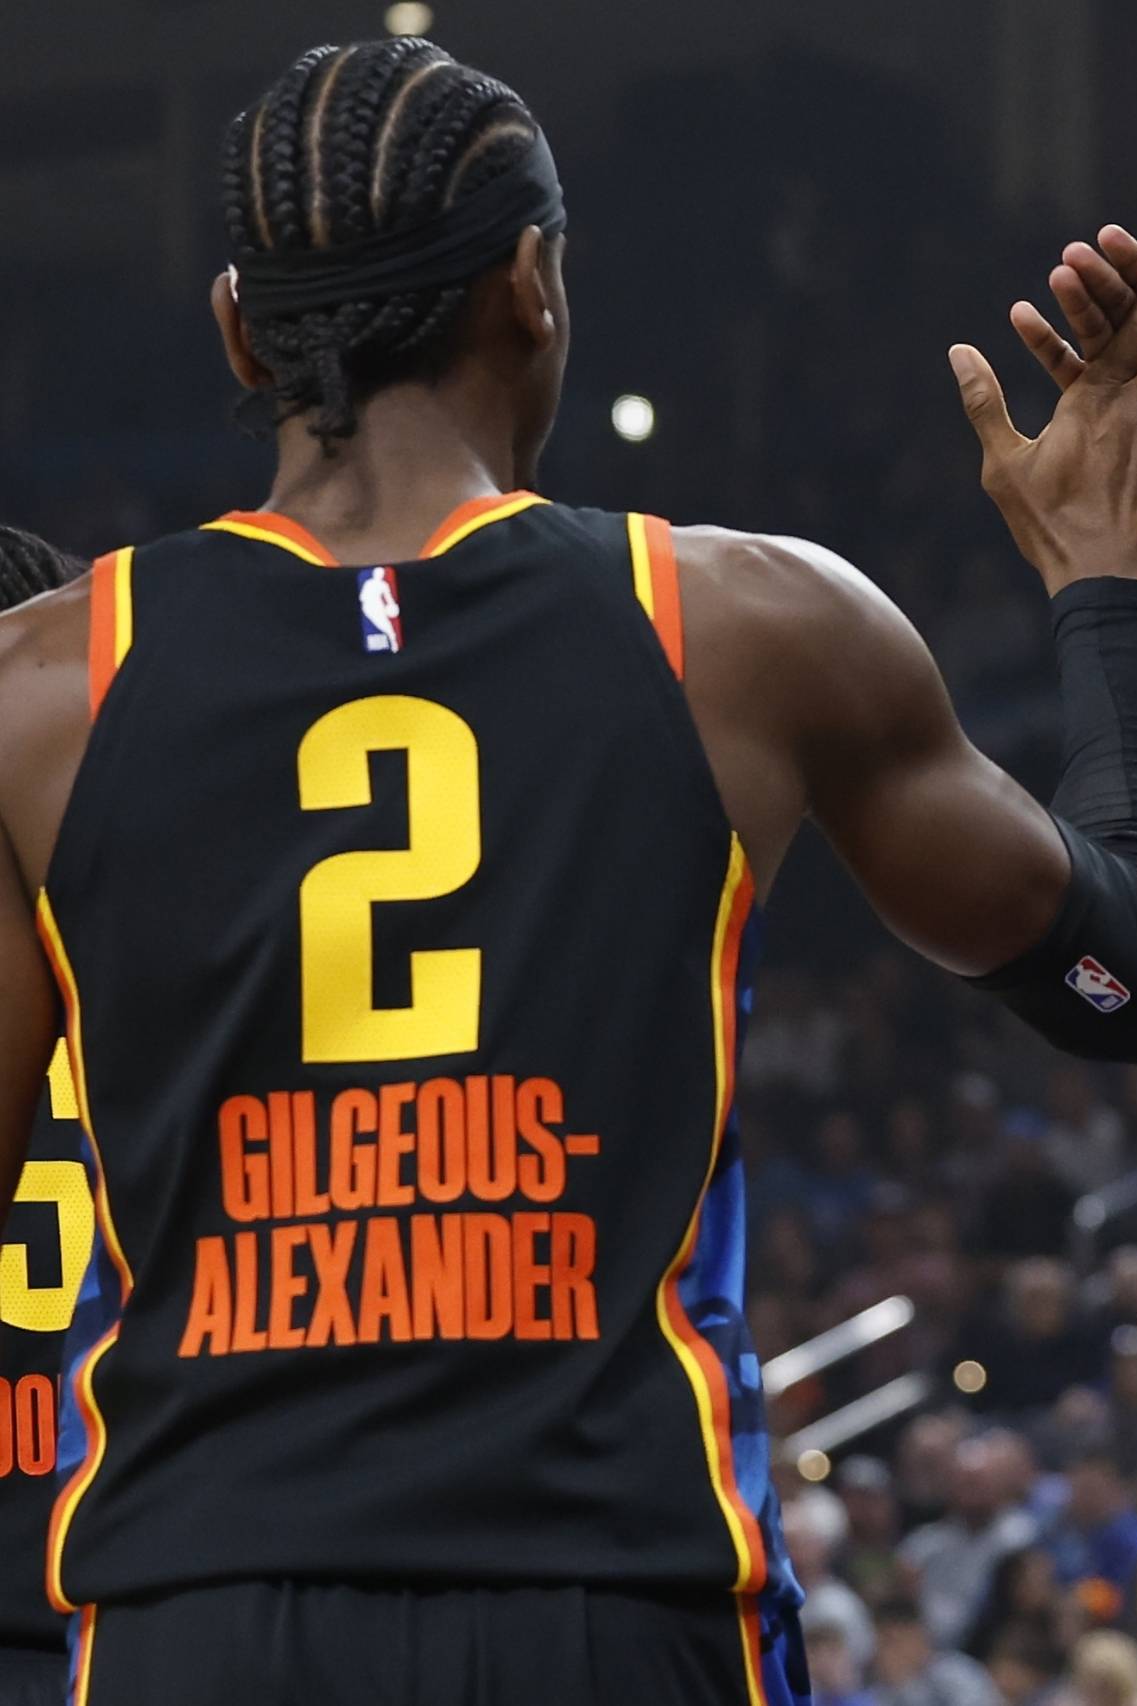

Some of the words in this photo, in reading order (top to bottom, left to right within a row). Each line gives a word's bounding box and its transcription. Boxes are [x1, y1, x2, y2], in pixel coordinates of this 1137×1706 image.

[297, 694, 482, 1064] 2
[218, 1075, 600, 1223] GILGEOUS-
[177, 1211, 600, 1358] ALEXANDER
